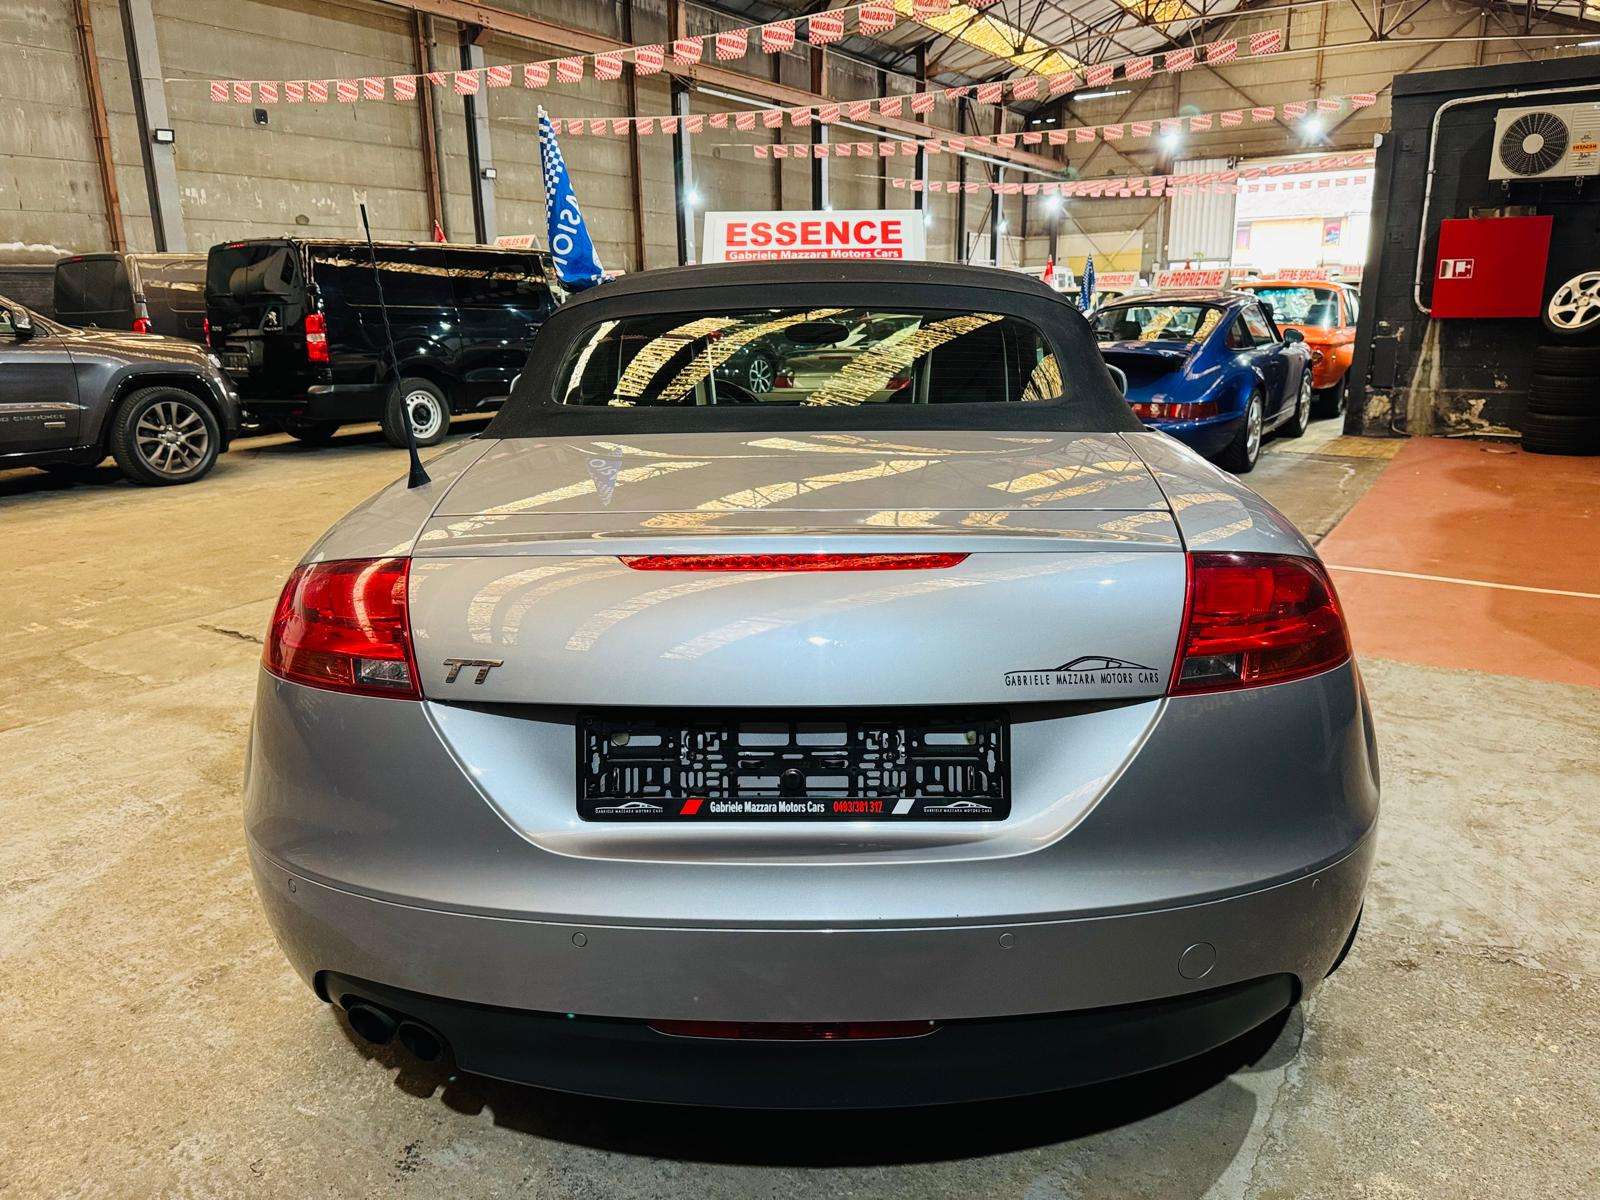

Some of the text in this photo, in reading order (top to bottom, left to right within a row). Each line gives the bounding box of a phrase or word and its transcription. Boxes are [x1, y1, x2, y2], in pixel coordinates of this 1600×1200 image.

[1209, 42, 1237, 61] OCCASION
[1251, 33, 1280, 53] OCCASION
[1126, 60, 1151, 77] OCCASION
[1167, 52, 1193, 70] OCCASION
[726, 220, 903, 247] ESSENCE
[729, 248, 899, 261] Gabriele Mazzara Motors Cars
[1156, 273, 1170, 287] 1er
[1170, 271, 1224, 286] PROPRIETAIRE
[443, 658, 504, 684] TT
[1004, 672, 1160, 687] GABRIELE MAZZARA MOTORS CARS
[710, 801, 743, 813] Gabriele
[744, 801, 777, 813] Mazzara
[778, 801, 806, 813] Motors
[807, 801, 825, 813] Cars
